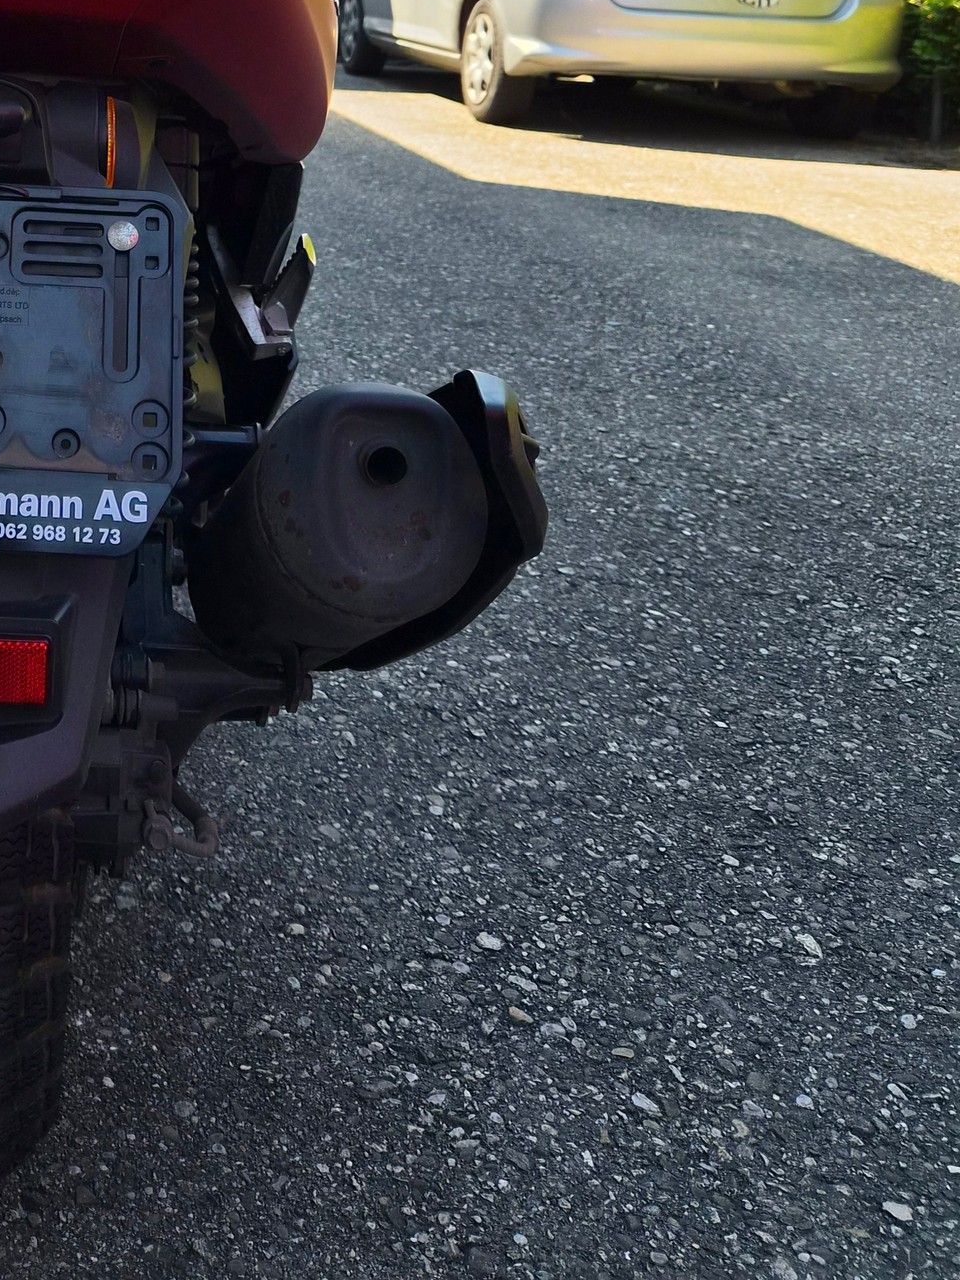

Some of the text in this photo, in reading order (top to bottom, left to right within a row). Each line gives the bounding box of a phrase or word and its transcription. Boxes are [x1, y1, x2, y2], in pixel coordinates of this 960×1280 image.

[14, 302, 29, 310] LTD
[93, 489, 148, 523] AG
[32, 525, 66, 542] 968
[72, 527, 93, 543] 12
[99, 528, 121, 545] 73
